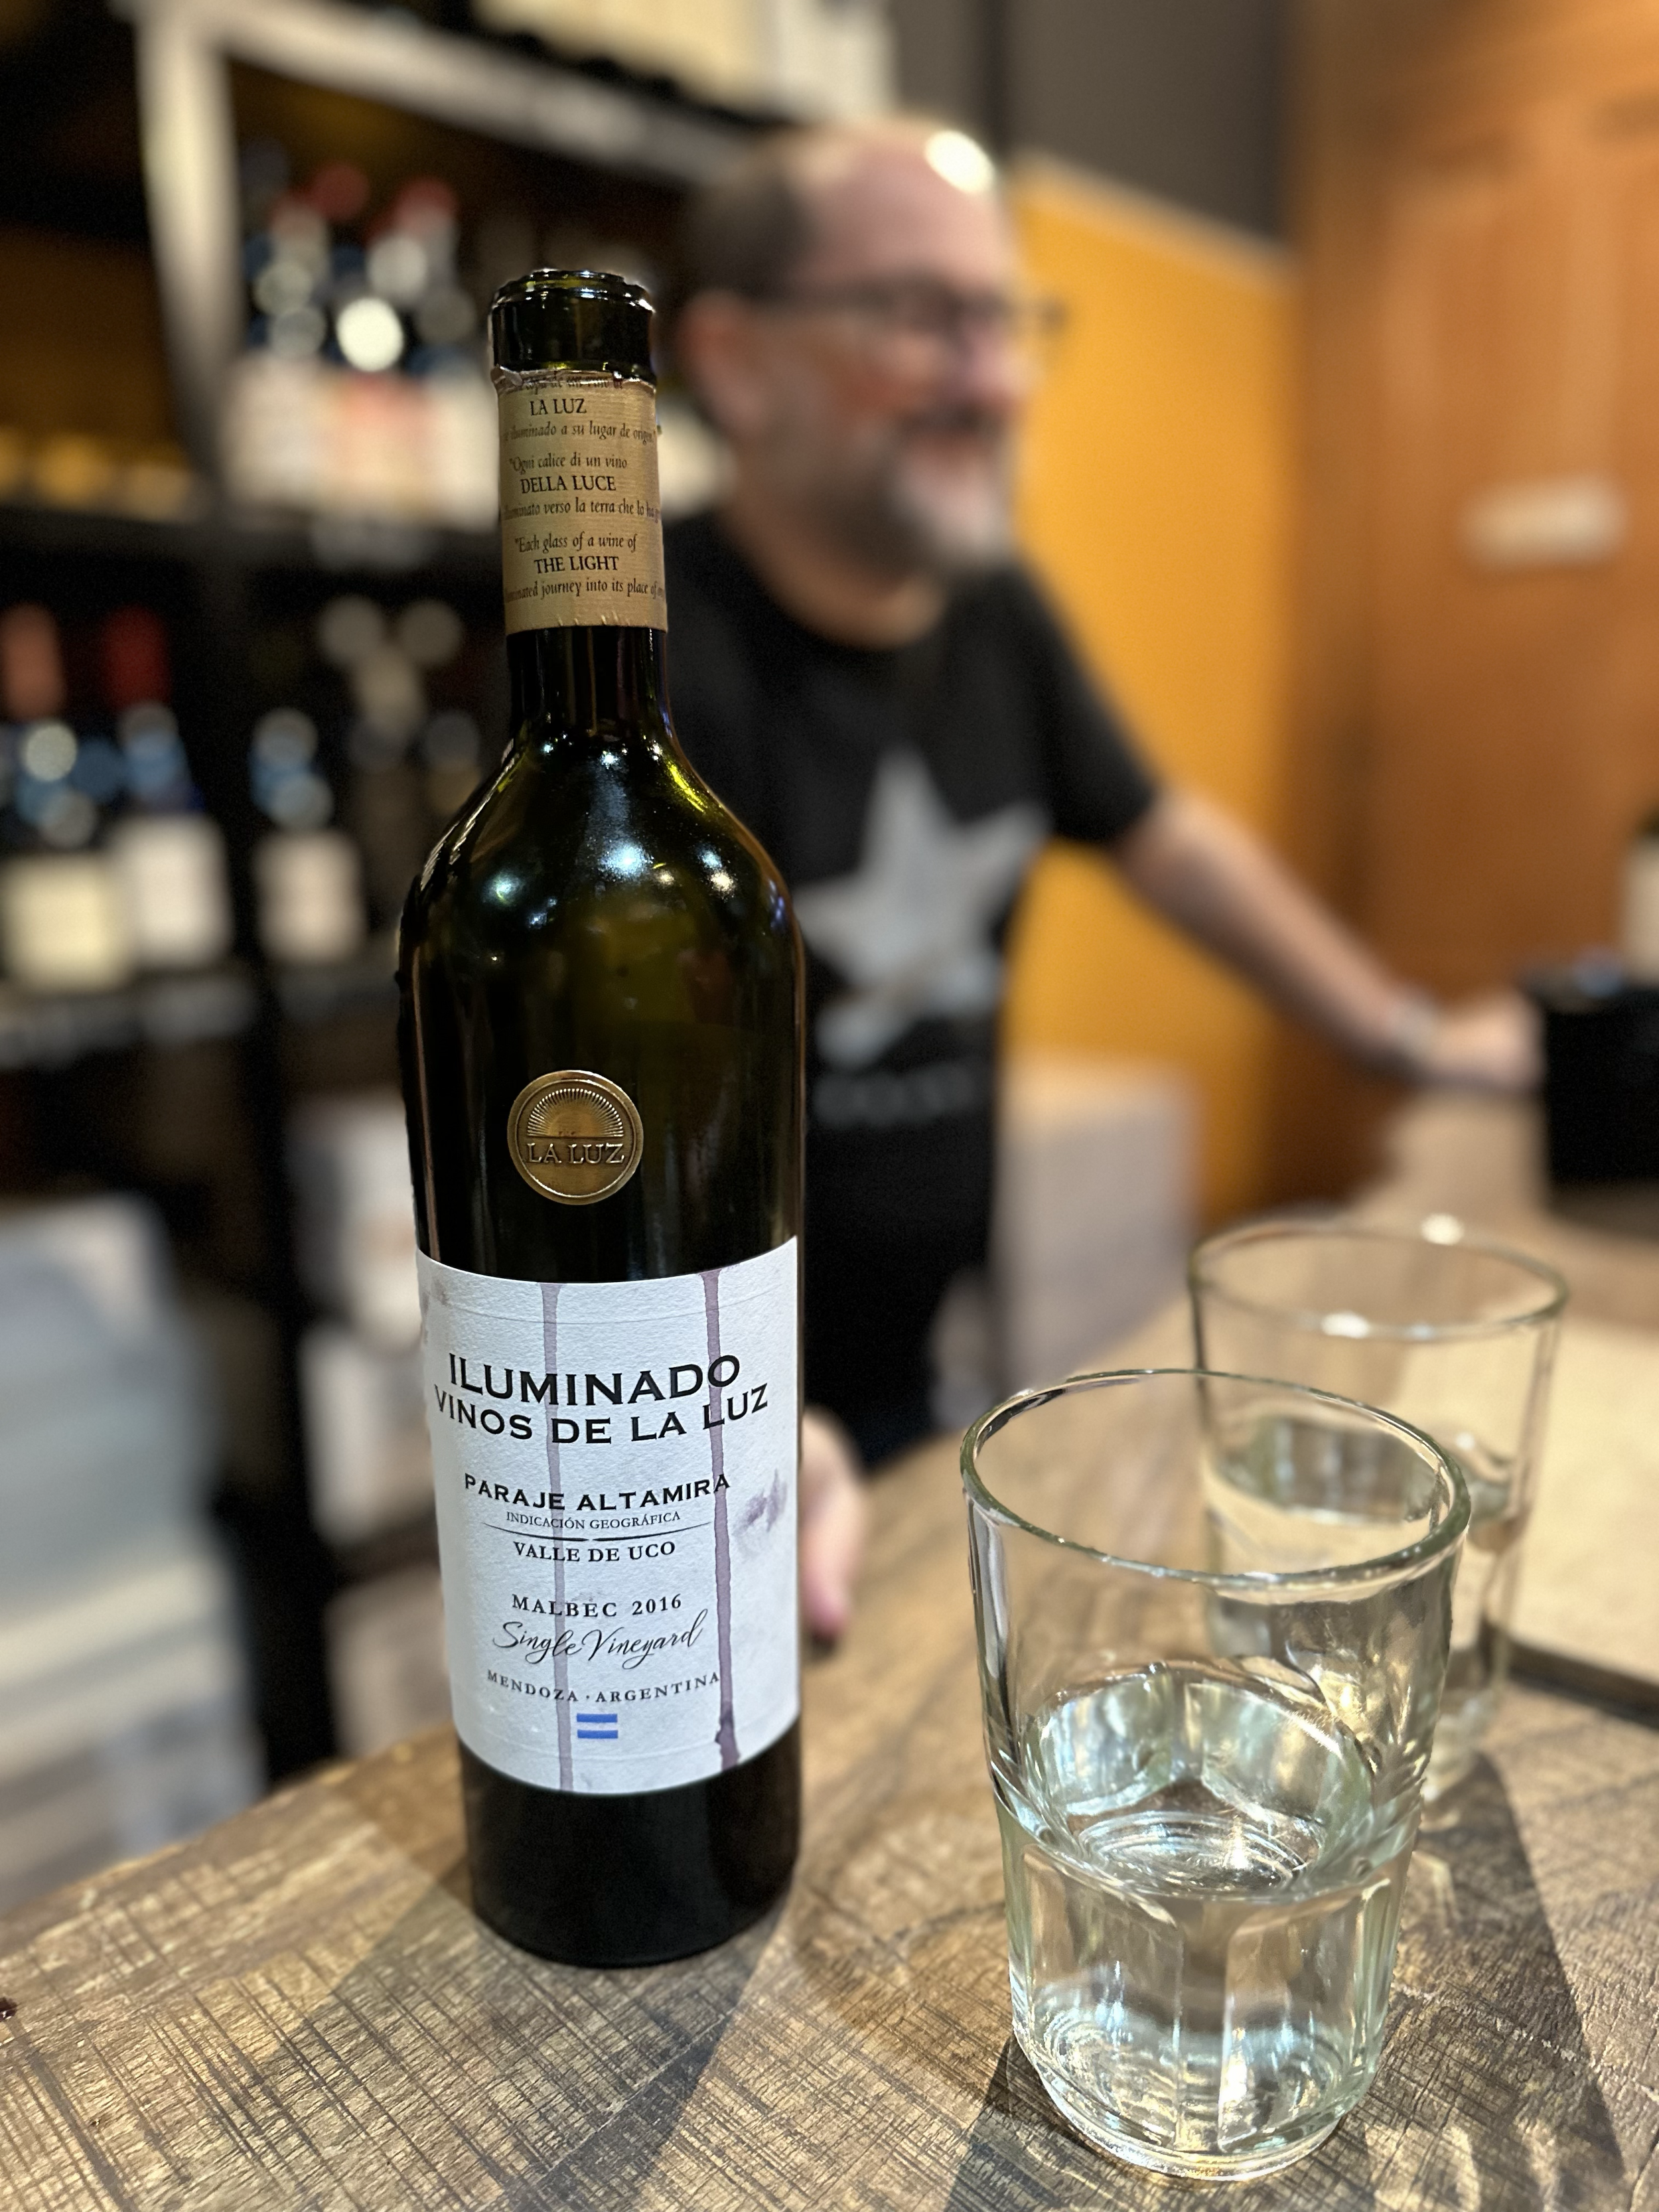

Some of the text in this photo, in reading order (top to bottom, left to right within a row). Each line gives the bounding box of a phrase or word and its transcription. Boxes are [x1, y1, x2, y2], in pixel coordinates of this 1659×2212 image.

[530, 398, 587, 416] LA LUZ
[561, 425, 567, 435] a
[571, 425, 584, 435] su
[589, 420, 616, 440] lugar
[620, 423, 630, 437] de
[538, 453, 566, 468] calice
[570, 451, 581, 467] di
[586, 457, 601, 467] un
[605, 454, 627, 469] vino
[520, 475, 616, 494] DELLA LUCE
[544, 502, 571, 514] verso
[575, 496, 585, 513] la
[591, 500, 614, 513] terra
[618, 498, 634, 515] che
[637, 500, 644, 516] lo
[542, 533, 568, 553] glass
[573, 531, 585, 552] of
[587, 537, 594, 547] a
[599, 533, 624, 548] wine
[628, 534, 638, 553] of
[534, 555, 619, 574] THE LIGHT
[540, 581, 581, 600] journey
[586, 577, 608, 592] into
[612, 577, 624, 592] its
[627, 577, 648, 597] place
[527, 1142, 625, 1164] LA LUZ
[449, 1353, 740, 1406] ILUMINADO
[434, 1382, 768, 1445] VINOS DE LA LUZ
[465, 1473, 731, 1511] PARAJE ALTAMIRA
[506, 1511, 681, 1530] INDICACIÓN GEOGRÁFICA
[512, 1540, 676, 1563] VALLE DE UCO
[512, 1593, 682, 1618] MALBEC 2016
[492, 1608, 709, 1670] Single Vineyard
[487, 1669, 720, 1704] MENDOZA ARGENTINA
